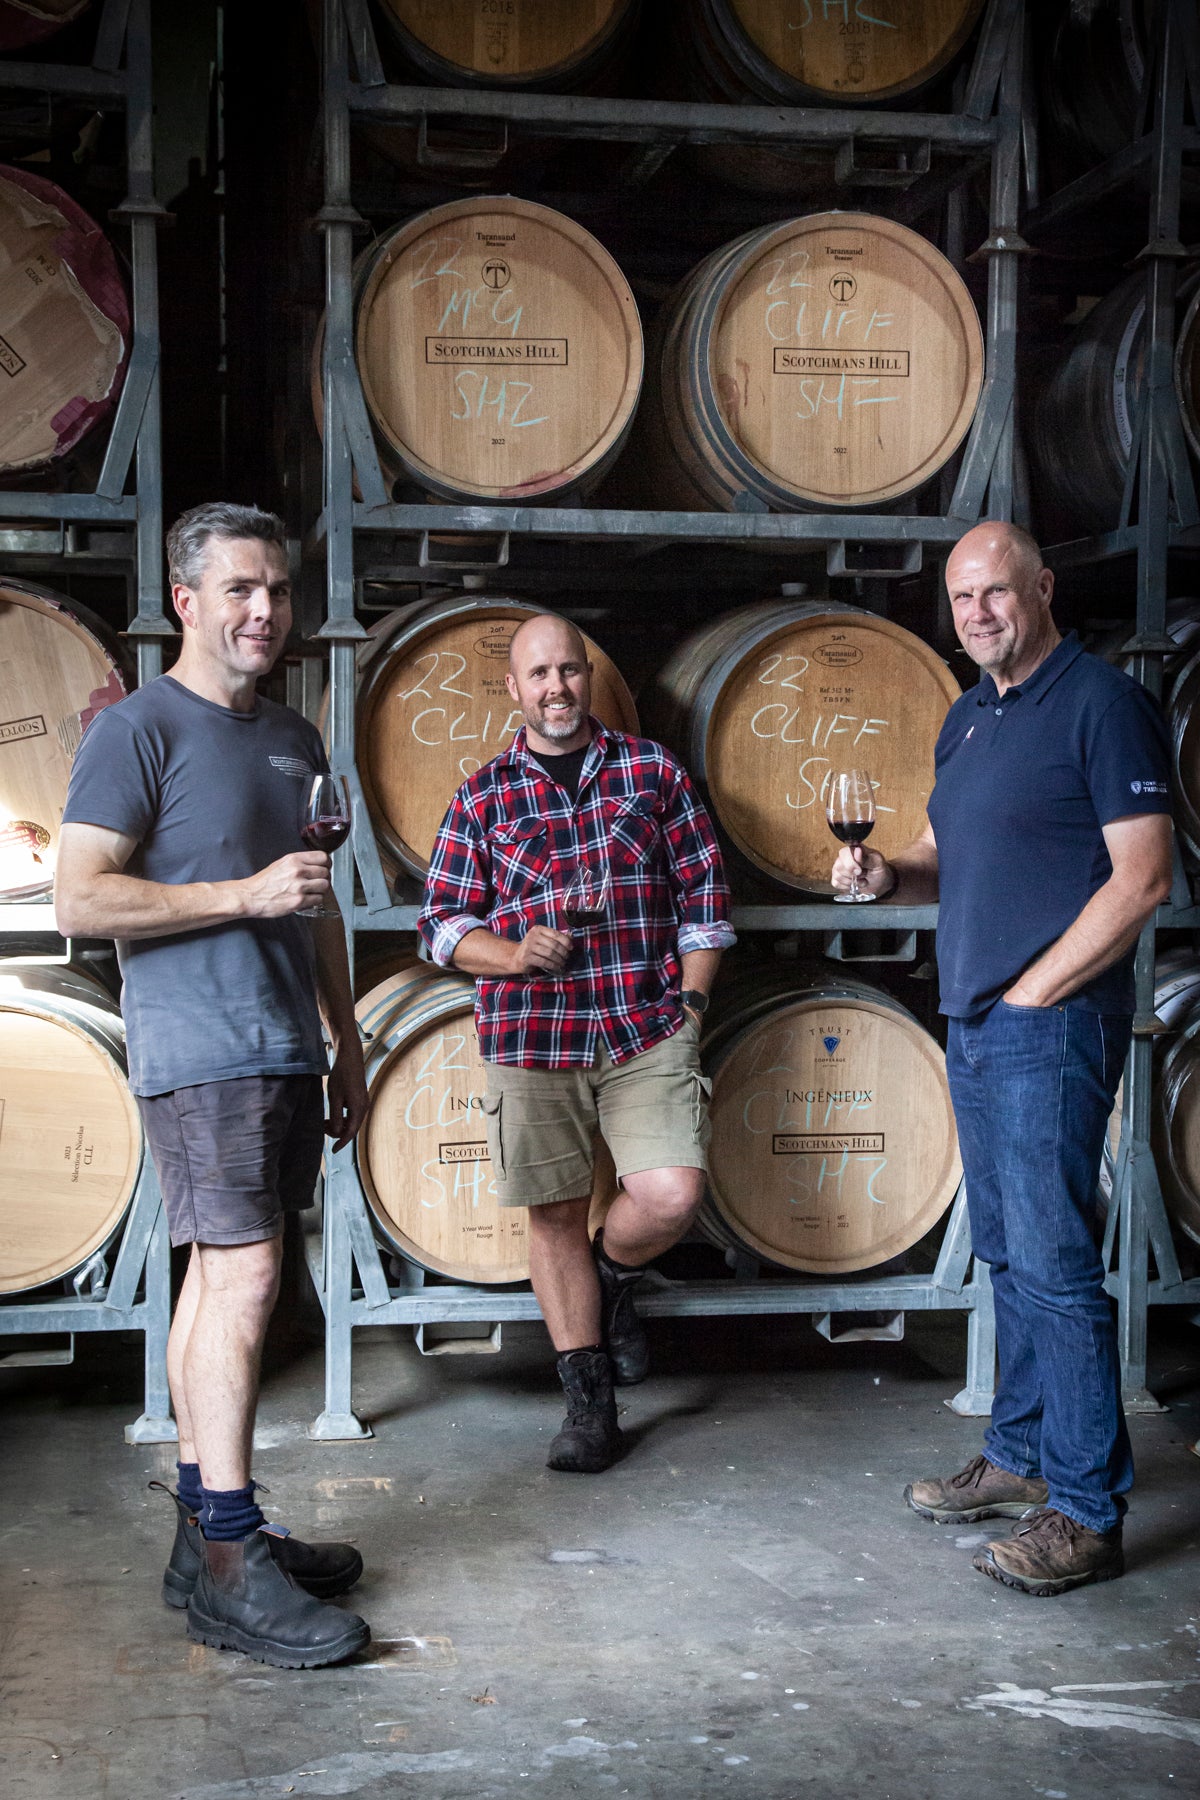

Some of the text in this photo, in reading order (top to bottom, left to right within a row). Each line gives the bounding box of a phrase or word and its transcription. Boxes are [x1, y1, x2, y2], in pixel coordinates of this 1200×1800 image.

[759, 251, 815, 295] 22
[764, 301, 896, 343] CLIFF
[434, 343, 560, 359] SCOTCHMANS HILL
[782, 354, 902, 370] SCOTCHMANS HILL
[397, 651, 473, 700] 22
[758, 654, 809, 692] 22
[751, 703, 889, 748] CLIFF
[809, 1026, 851, 1036] TRUST
[786, 1089, 873, 1103] INGÉNIEUX
[778, 1137, 880, 1150] SCOTCHMANS HILL
[445, 1146, 489, 1159] SCOTCH
